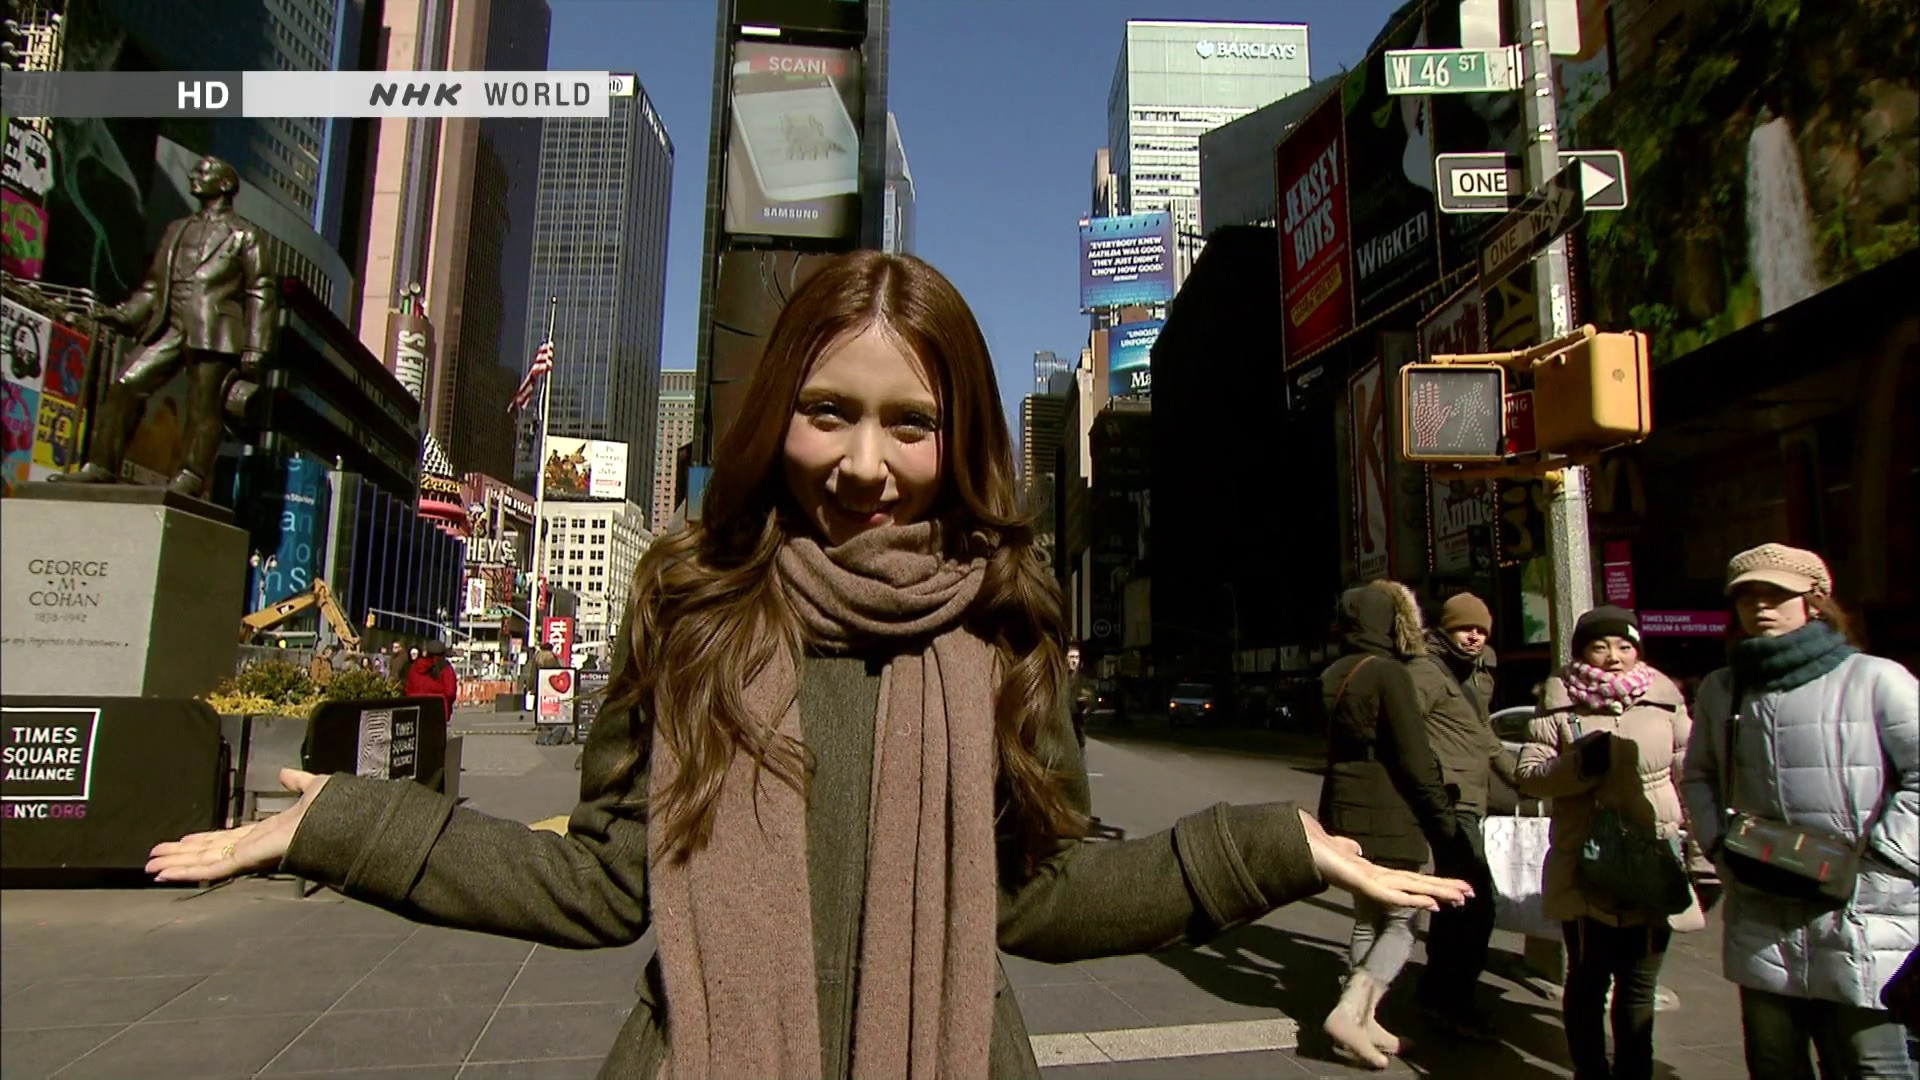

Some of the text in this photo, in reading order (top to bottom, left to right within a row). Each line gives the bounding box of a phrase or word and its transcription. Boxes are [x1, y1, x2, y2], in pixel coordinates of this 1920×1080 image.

[1217, 42, 1297, 59] BARCLAYS
[1392, 54, 1478, 87] W 46 ST
[1284, 137, 1338, 235] JERSEY
[1459, 172, 1509, 193] ONE
[763, 207, 819, 219] SAMSUNG
[1138, 236, 1162, 246] KNEW
[1294, 197, 1336, 272] BOYS
[1088, 245, 1166, 259] MATILDA WAS GOOD,
[1490, 228, 1517, 266] ONE
[1091, 267, 1116, 276] KNOW
[1117, 265, 1137, 274] HOW
[1093, 259, 1113, 267] THEY
[1114, 257, 1132, 265] JUST
[1438, 487, 1494, 535] Annie
[28, 559, 109, 577] GEORGE
[28, 591, 100, 607] COHAN
[1641, 614, 1692, 624] TIMES SQUARE
[12, 727, 78, 744] TIMES
[3, 747, 82, 766] SQUARE
[5, 768, 76, 781] ALLIANCE
